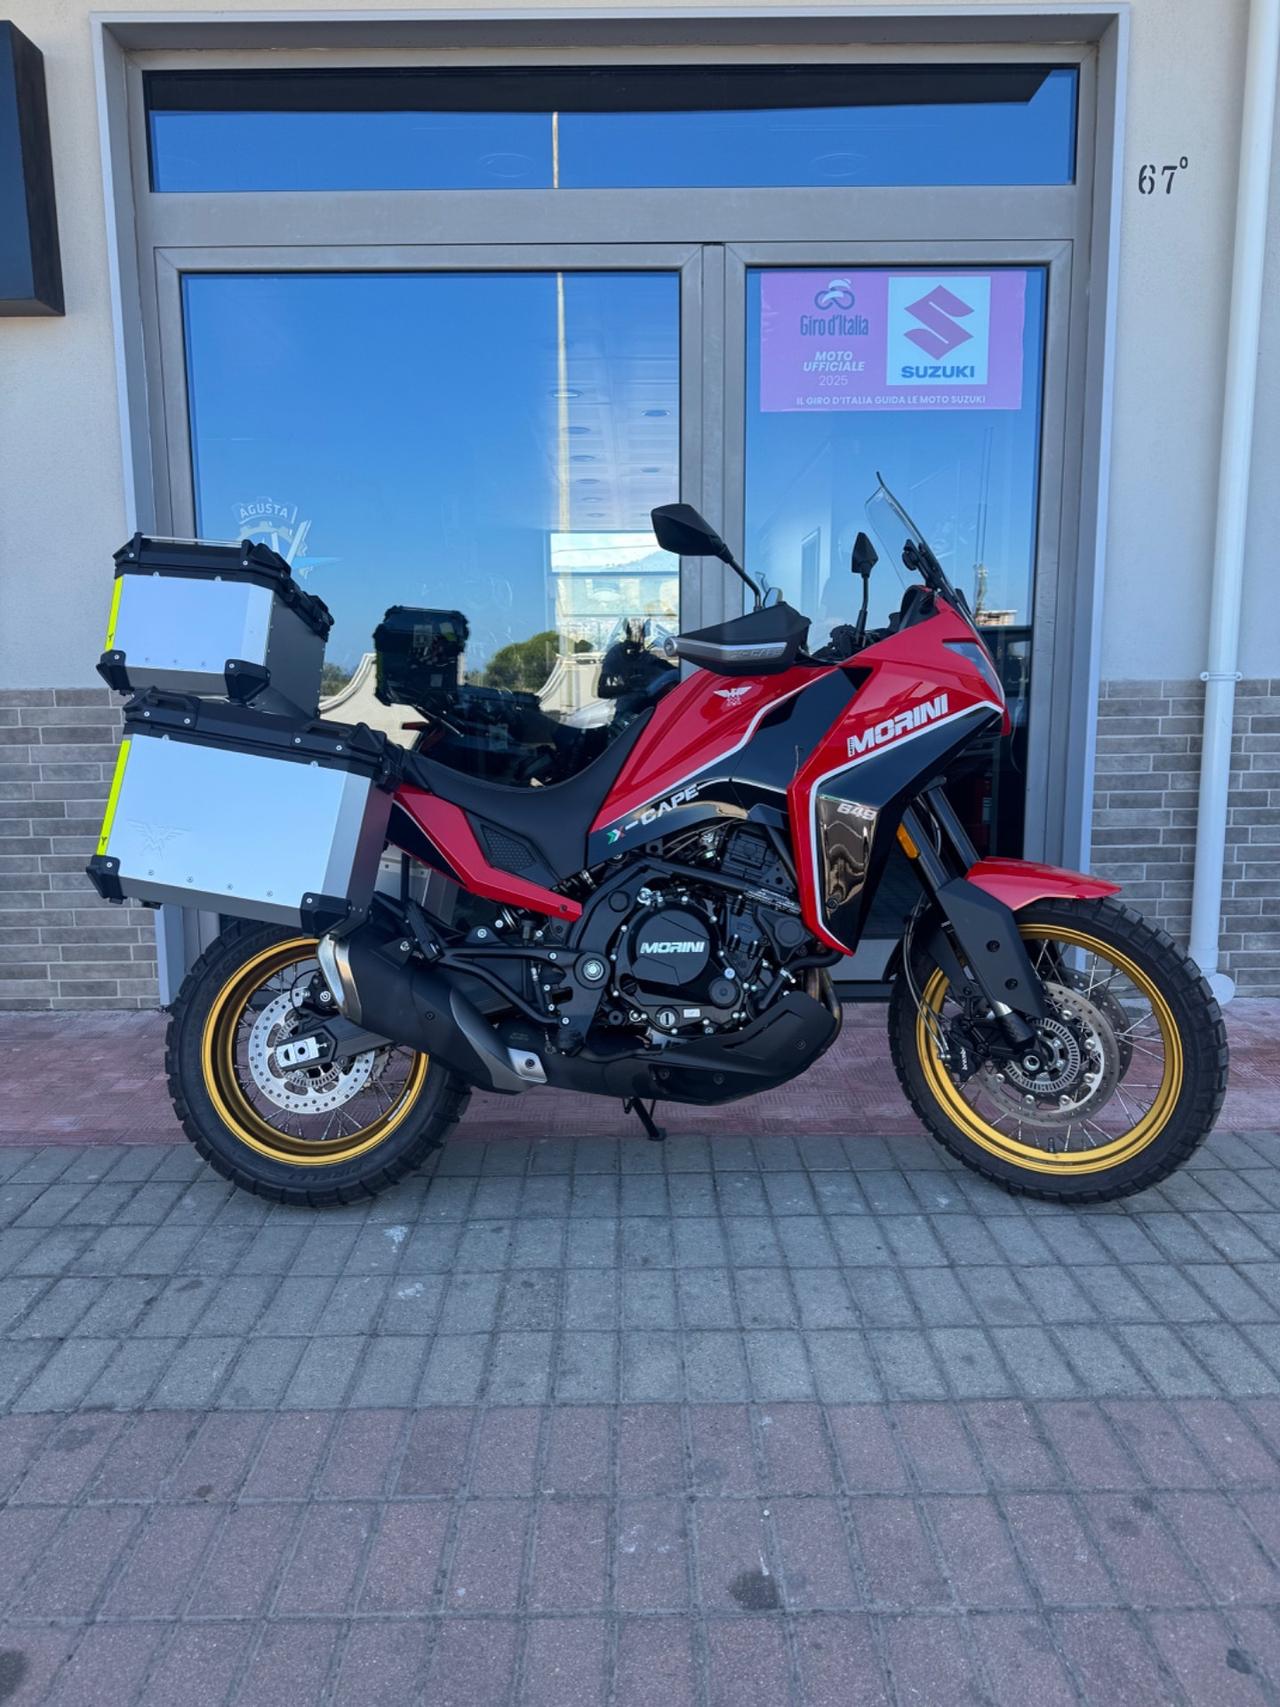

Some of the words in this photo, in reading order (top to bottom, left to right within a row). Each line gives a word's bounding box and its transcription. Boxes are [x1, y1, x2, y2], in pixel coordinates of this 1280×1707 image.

[800, 315, 826, 336] Giro
[828, 314, 869, 336] d'Italia
[815, 350, 853, 361] MOTO
[803, 361, 865, 372] UFFICIALE
[900, 365, 976, 379] SUZUKI
[818, 375, 849, 386] 2025
[796, 396, 805, 406] IL
[806, 396, 831, 406] GIRO
[832, 396, 873, 405] D'ITALIA
[874, 395, 906, 405] GUIDA
[907, 395, 919, 404] LE
[919, 395, 949, 404] MOTO
[950, 395, 986, 404] SUZUKI
[239, 502, 288, 520] AGUSTA
[847, 693, 949, 758] MORINI
[837, 802, 878, 821] 649
[640, 941, 705, 954] MORINI
